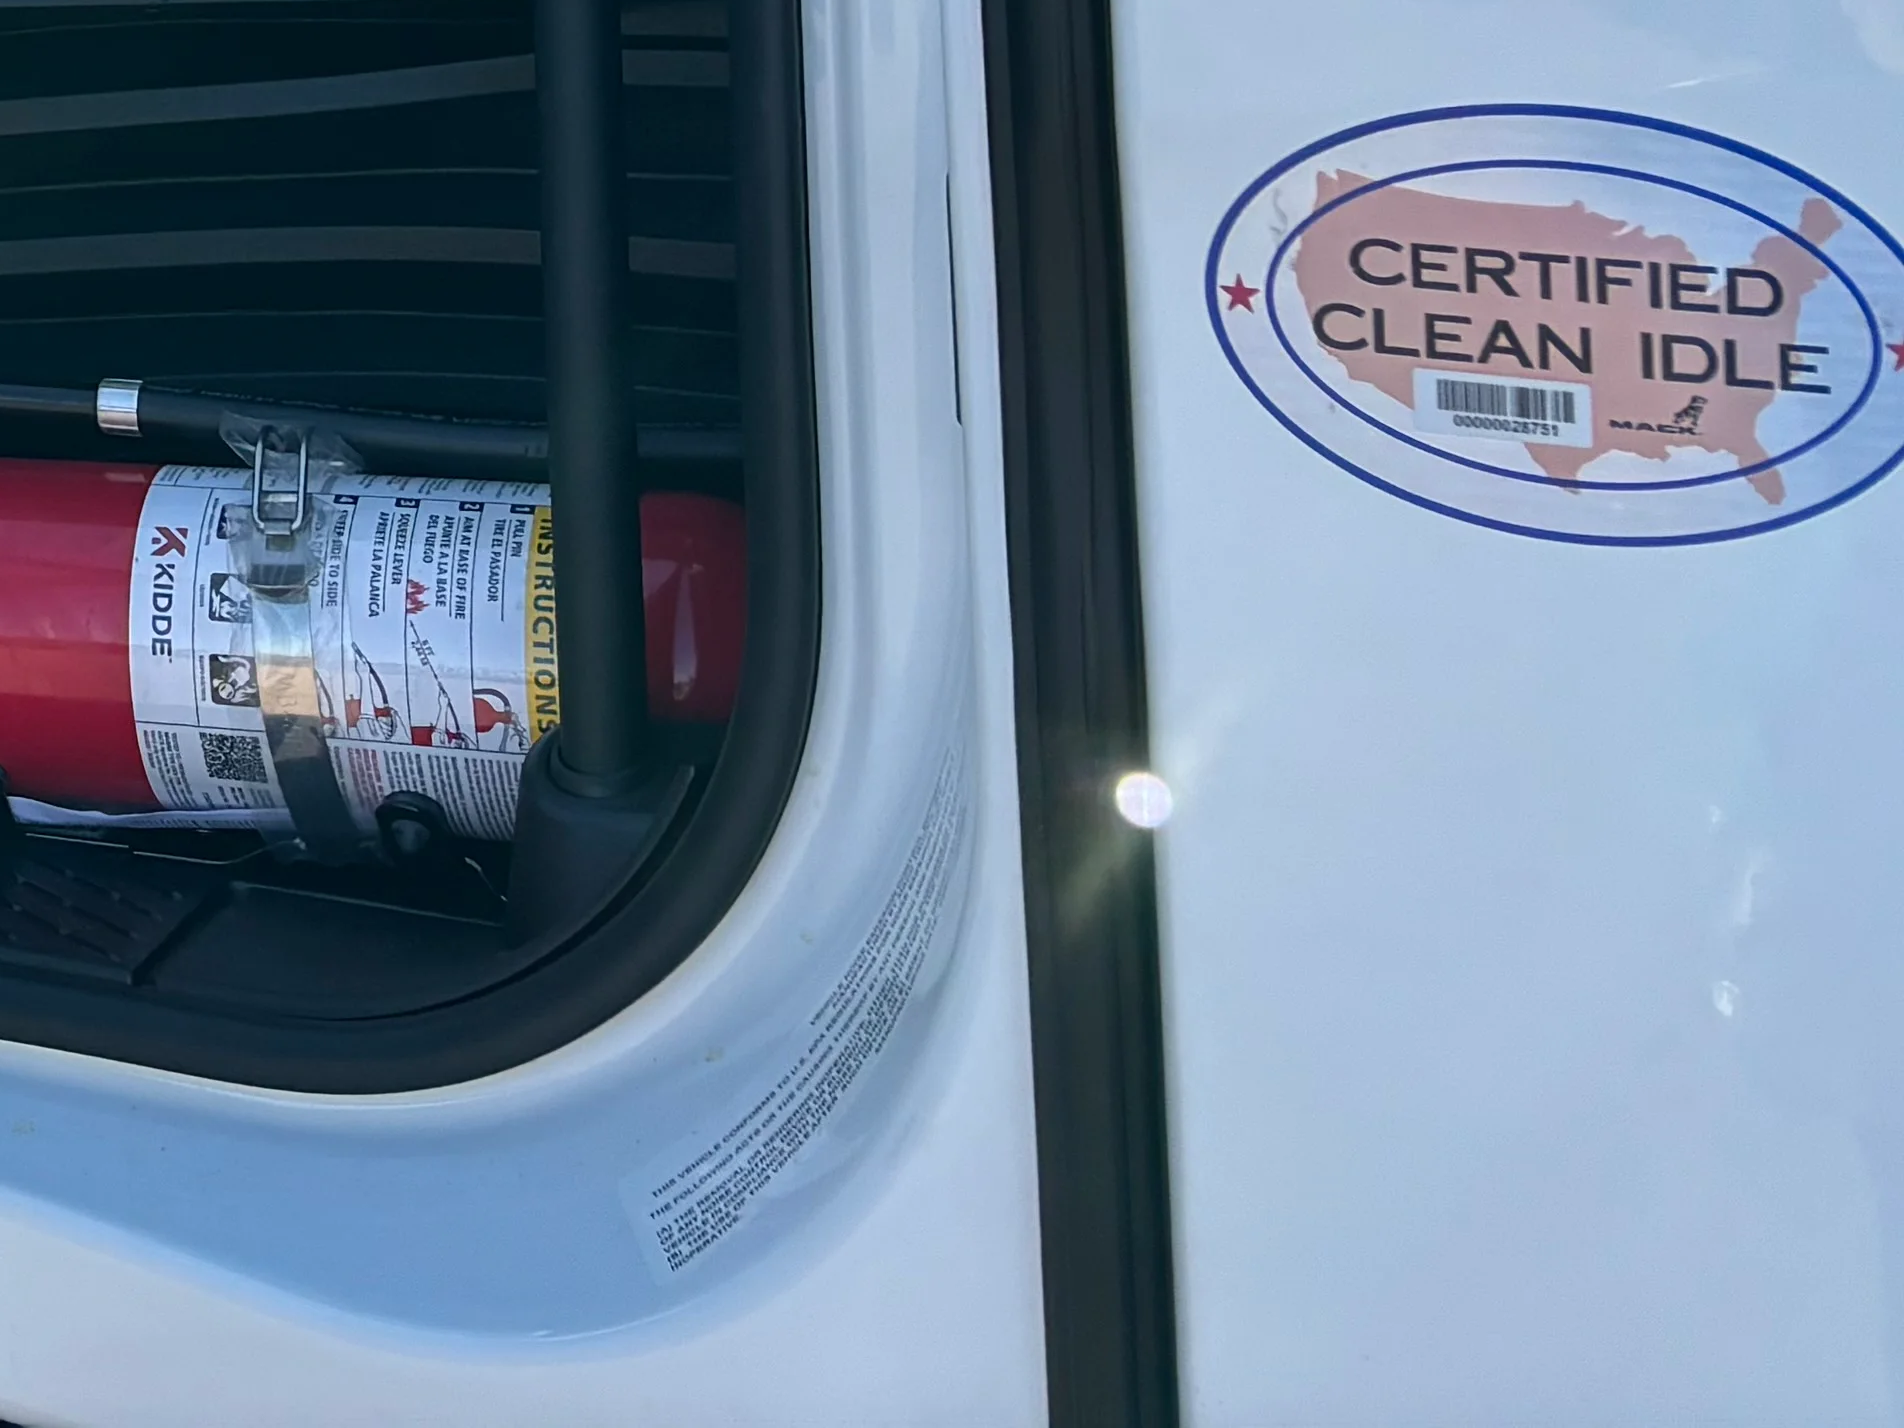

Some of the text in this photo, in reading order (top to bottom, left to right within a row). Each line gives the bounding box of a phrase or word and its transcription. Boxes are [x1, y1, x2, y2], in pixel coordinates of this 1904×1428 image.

[1348, 238, 1784, 318] CERTIFIED
[1312, 302, 1832, 395] CLEAN IDLE
[1608, 418, 1702, 436] MACK
[391, 513, 410, 584] SQUEEZE LEVER
[422, 531, 436, 563] FUEGO
[459, 534, 469, 546] AT
[510, 541, 522, 557] PIN
[371, 548, 384, 562] LA
[437, 561, 448, 575] LA
[456, 548, 468, 574] BASE
[328, 564, 342, 577] TO
[487, 551, 501, 602] PASADOR
[325, 581, 338, 607] SIDE
[368, 564, 383, 617] PALANCA
[435, 577, 447, 607] BASE
[455, 577, 466, 592] OF
[150, 563, 174, 657] KIDDE
[454, 595, 465, 619] FIRE
